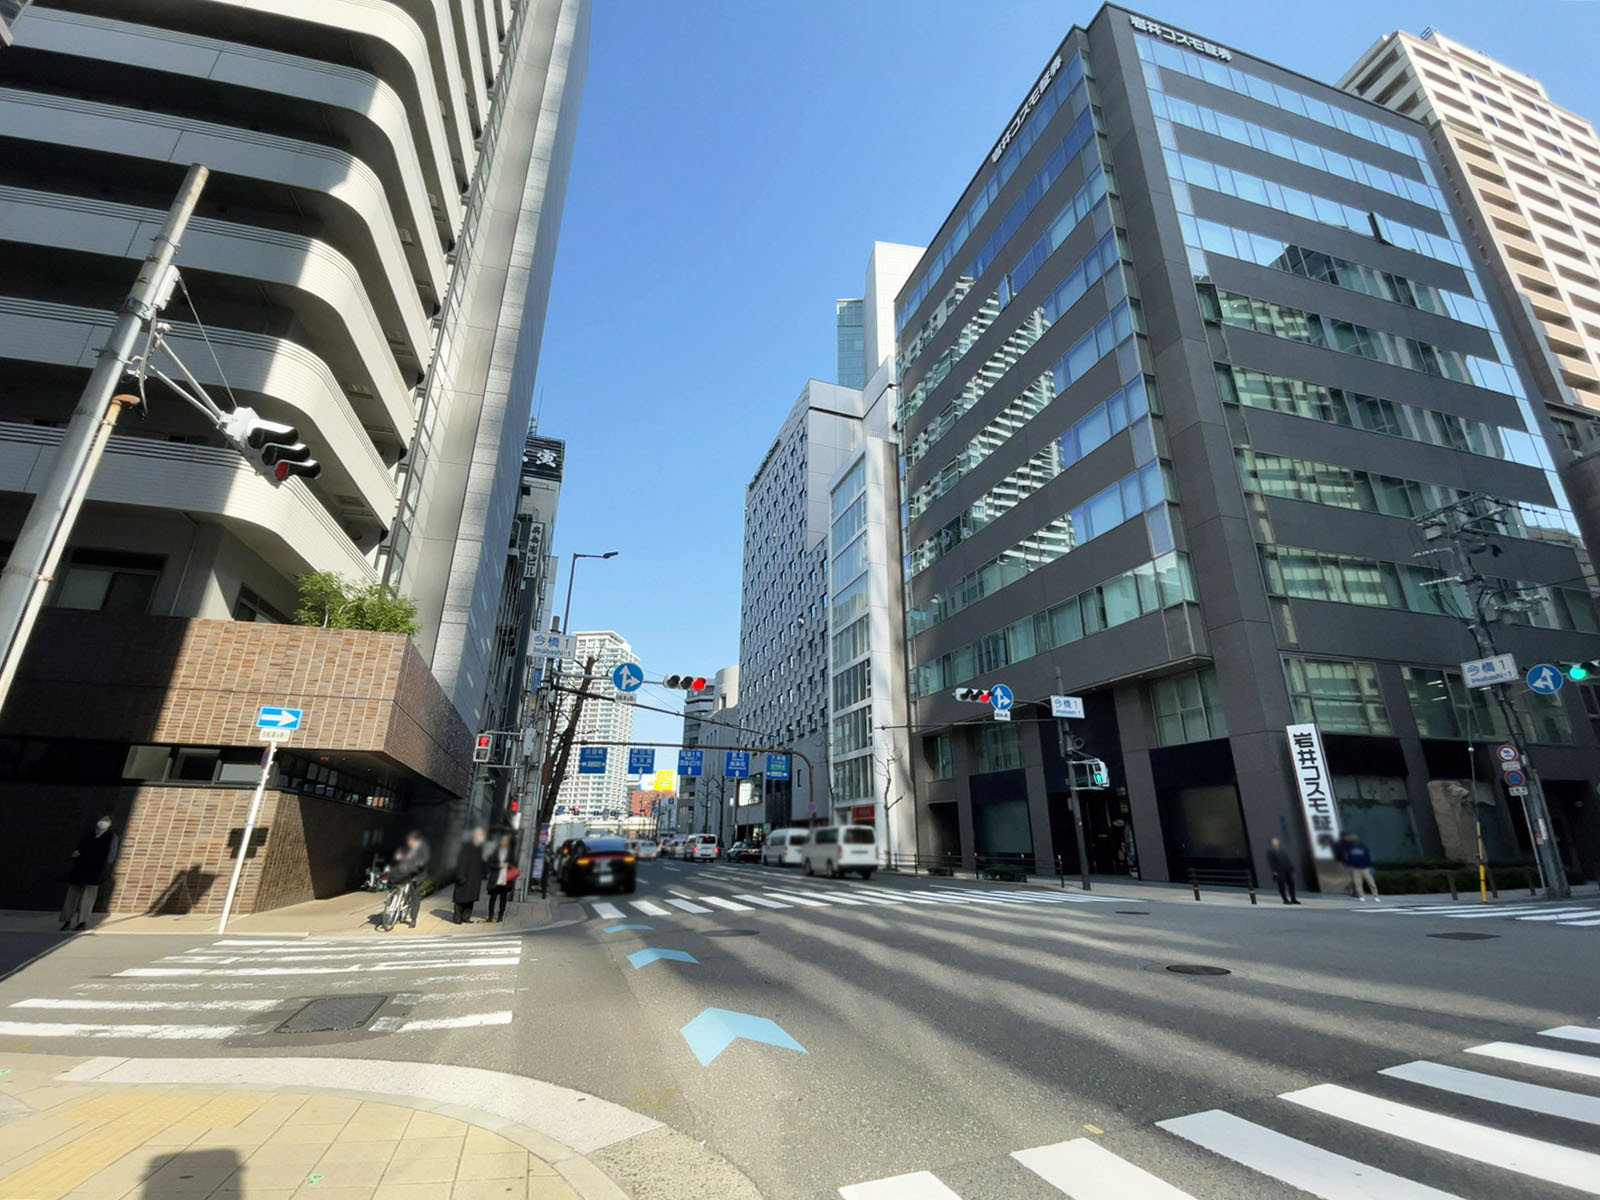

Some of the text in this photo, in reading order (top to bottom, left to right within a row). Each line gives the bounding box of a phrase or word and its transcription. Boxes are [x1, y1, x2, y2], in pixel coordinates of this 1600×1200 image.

[1129, 14, 1232, 61] 岩井コスモ証券
[991, 55, 1062, 163] 岩井コスモ証券
